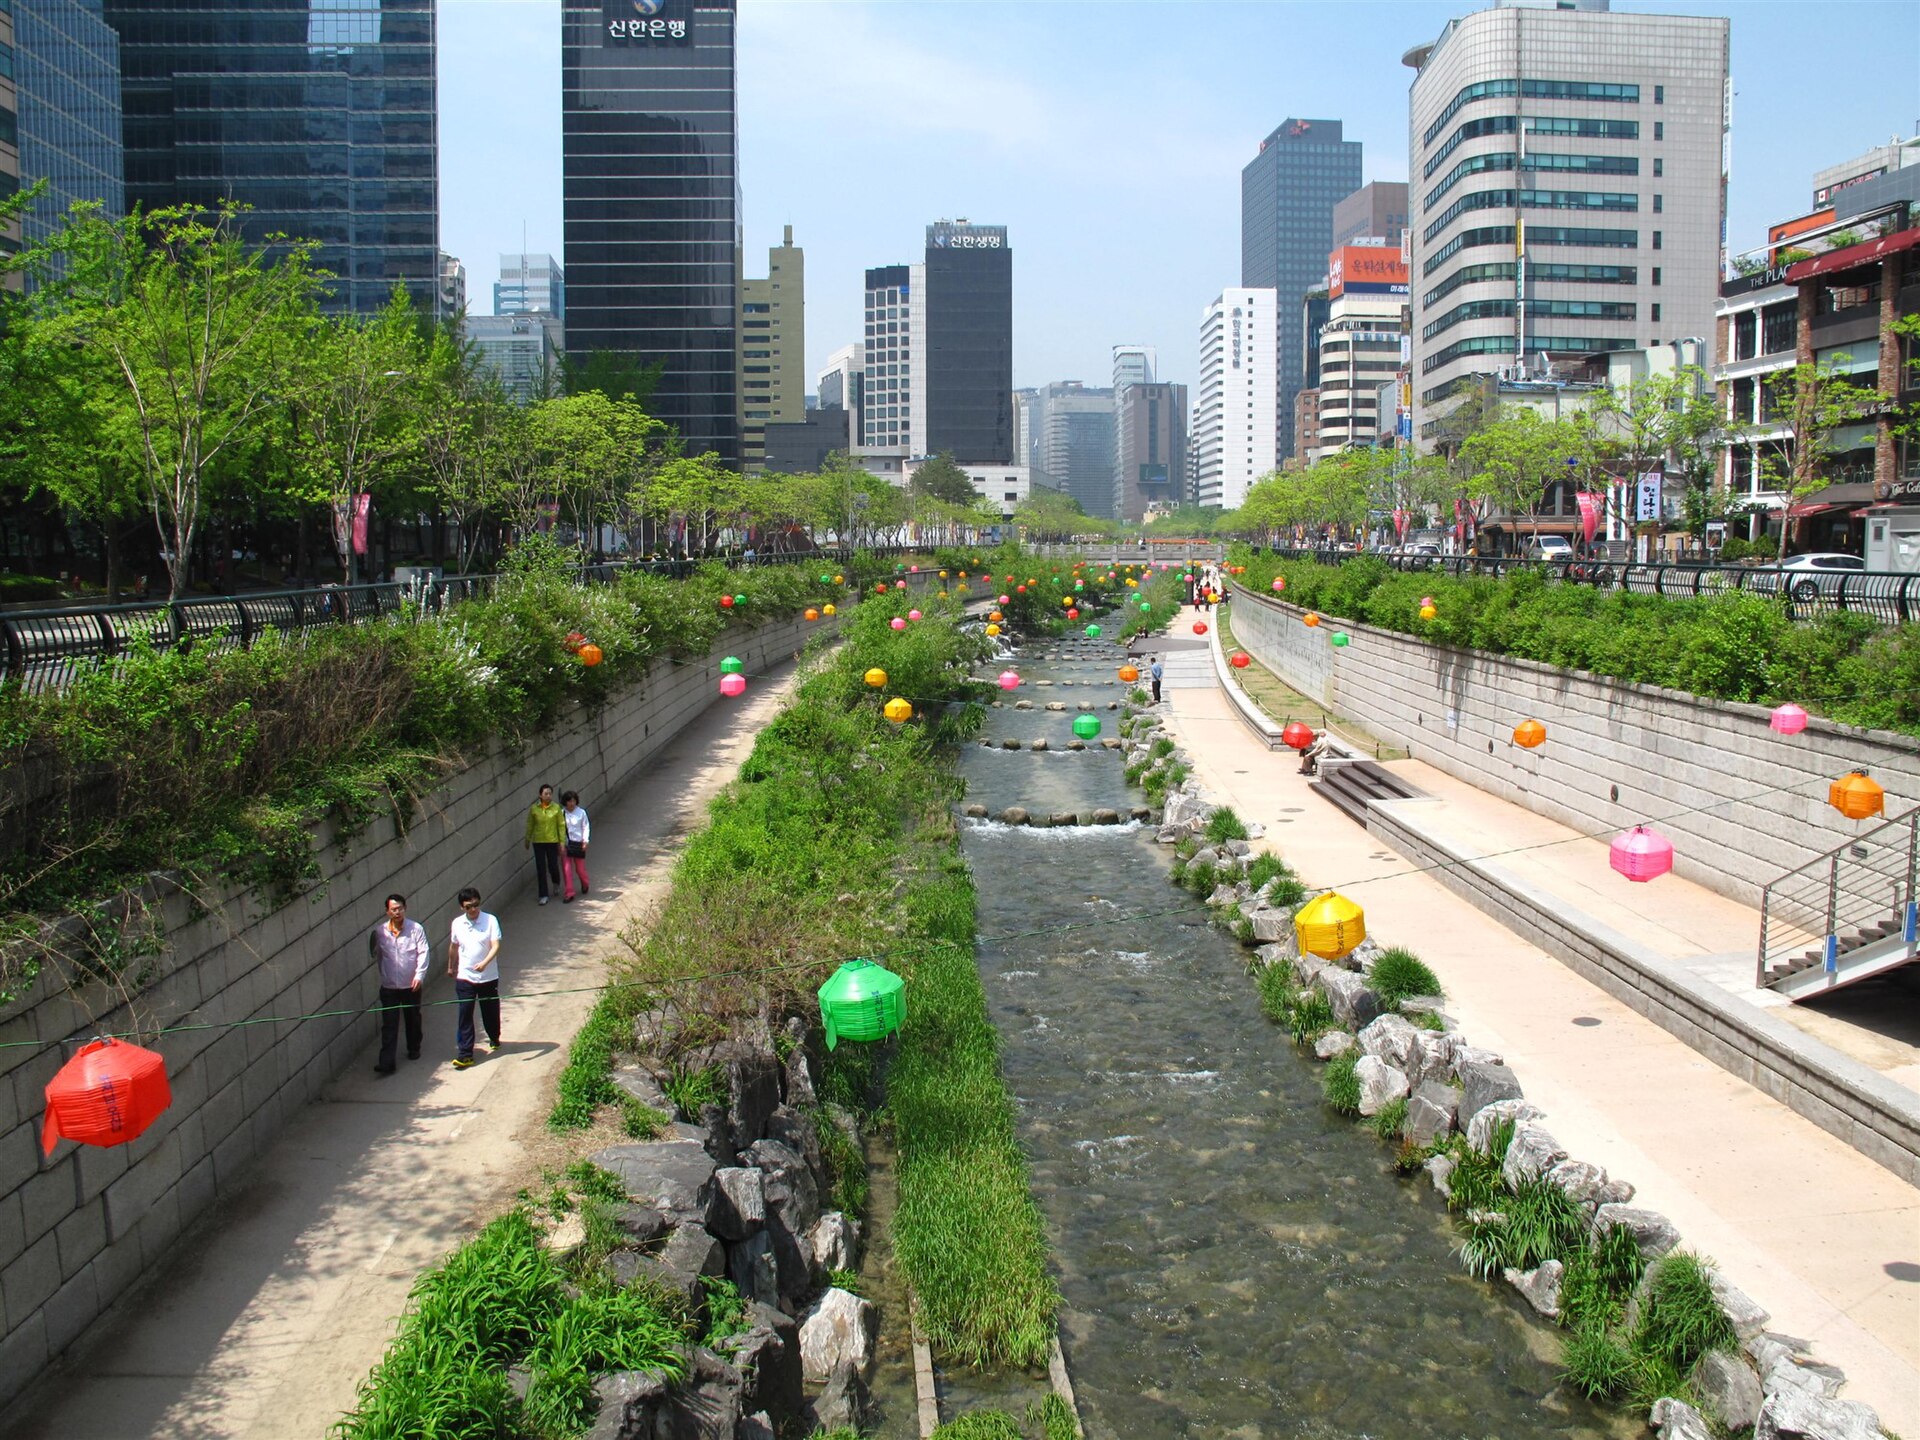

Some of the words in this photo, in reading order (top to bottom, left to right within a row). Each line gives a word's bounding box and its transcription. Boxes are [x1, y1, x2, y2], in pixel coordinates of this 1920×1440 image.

[608, 19, 686, 38] 신한은행
[950, 236, 1000, 248] 신한생명
[1750, 276, 1764, 288] THE
[1766, 261, 1797, 283] PLAC
